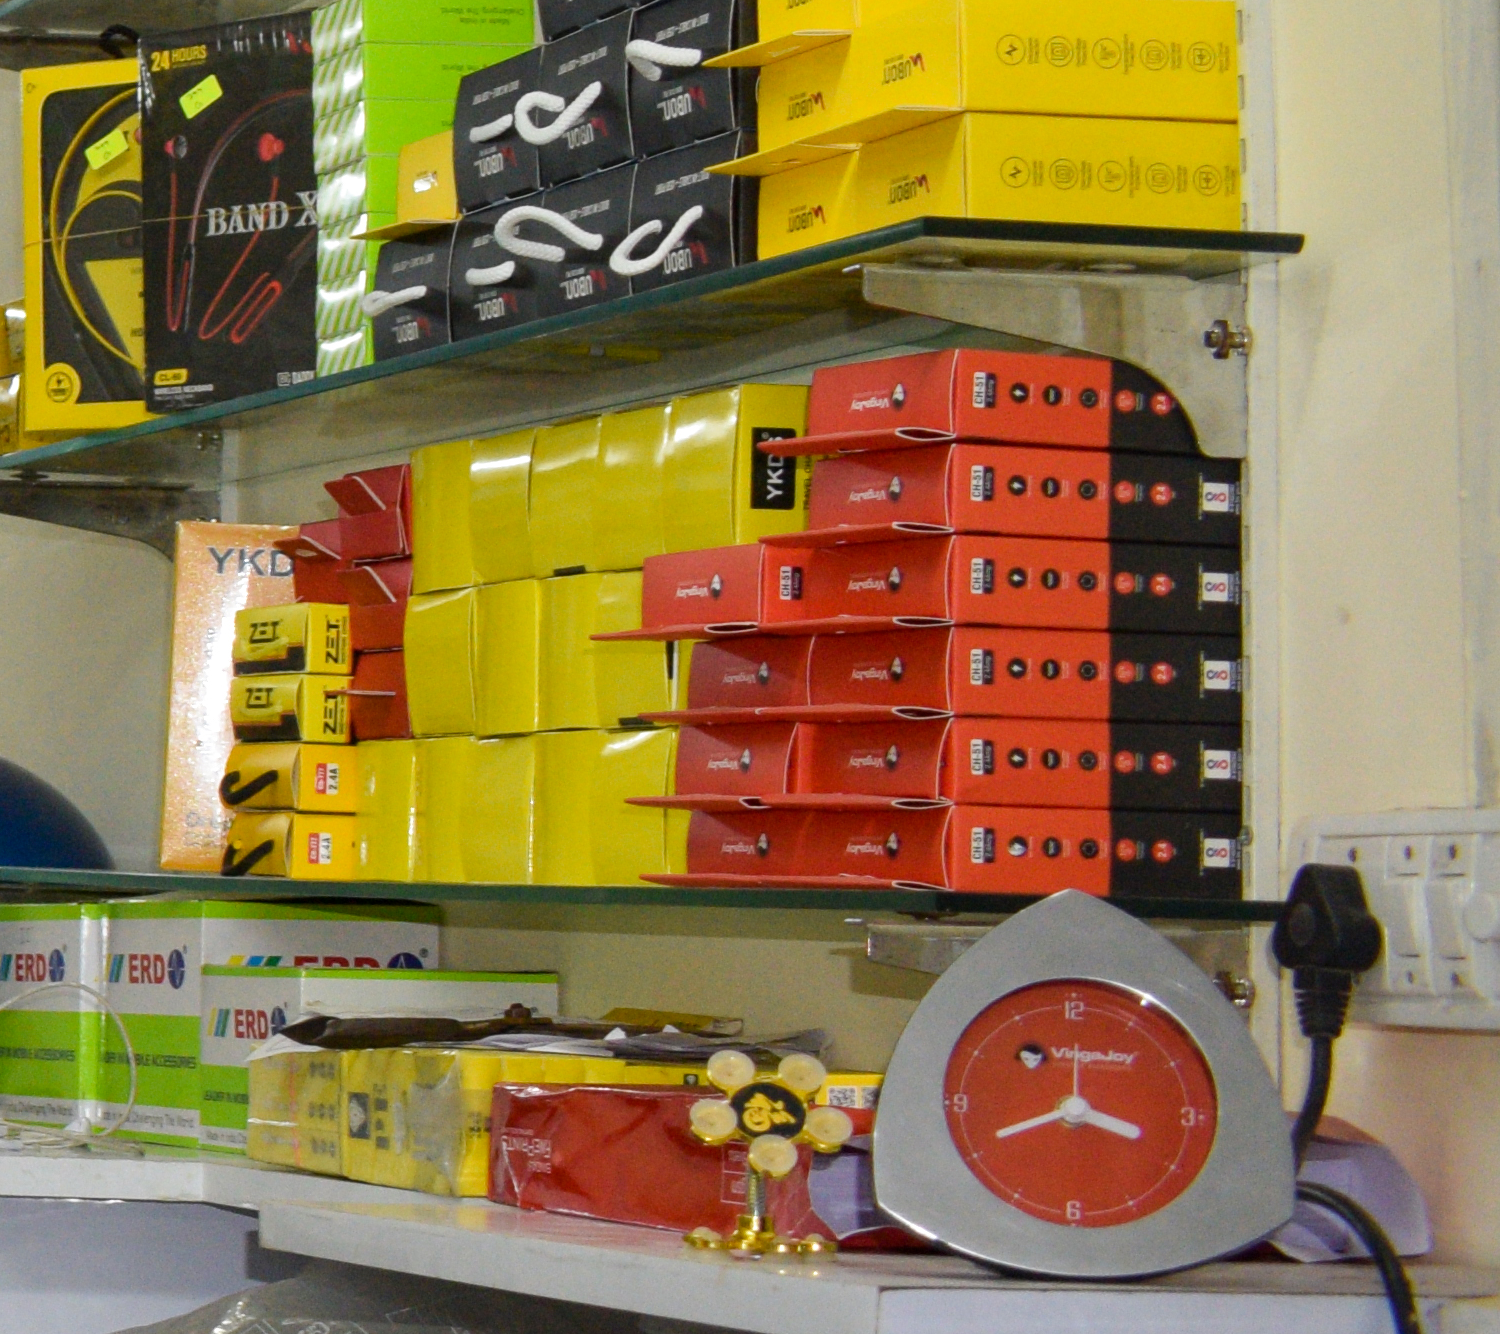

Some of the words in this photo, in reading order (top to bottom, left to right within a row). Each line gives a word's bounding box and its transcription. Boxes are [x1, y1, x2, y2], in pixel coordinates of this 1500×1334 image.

[151, 50, 172, 72] 24
[172, 44, 208, 63] HOURS
[205, 199, 289, 238] BAND
[975, 374, 986, 406] CH-51
[972, 468, 982, 500] CH-51
[206, 545, 294, 579] YKD
[972, 560, 982, 592] CH-51
[781, 567, 791, 598] CH-51
[325, 618, 340, 664] ZET
[972, 651, 982, 683] CH-51
[972, 741, 982, 773] CH-51
[328, 765, 339, 791] 2.4A
[973, 829, 983, 861] CH-51
[14, 953, 48, 983] ERD
[128, 953, 166, 984] ERD
[234, 1008, 268, 1040] ERD
[1063, 1000, 1084, 1021] 12
[1050, 1044, 1136, 1066] VingaJoy
[952, 1093, 968, 1113] 9
[1180, 1107, 1195, 1127] 3
[1065, 1200, 1081, 1221] 6
